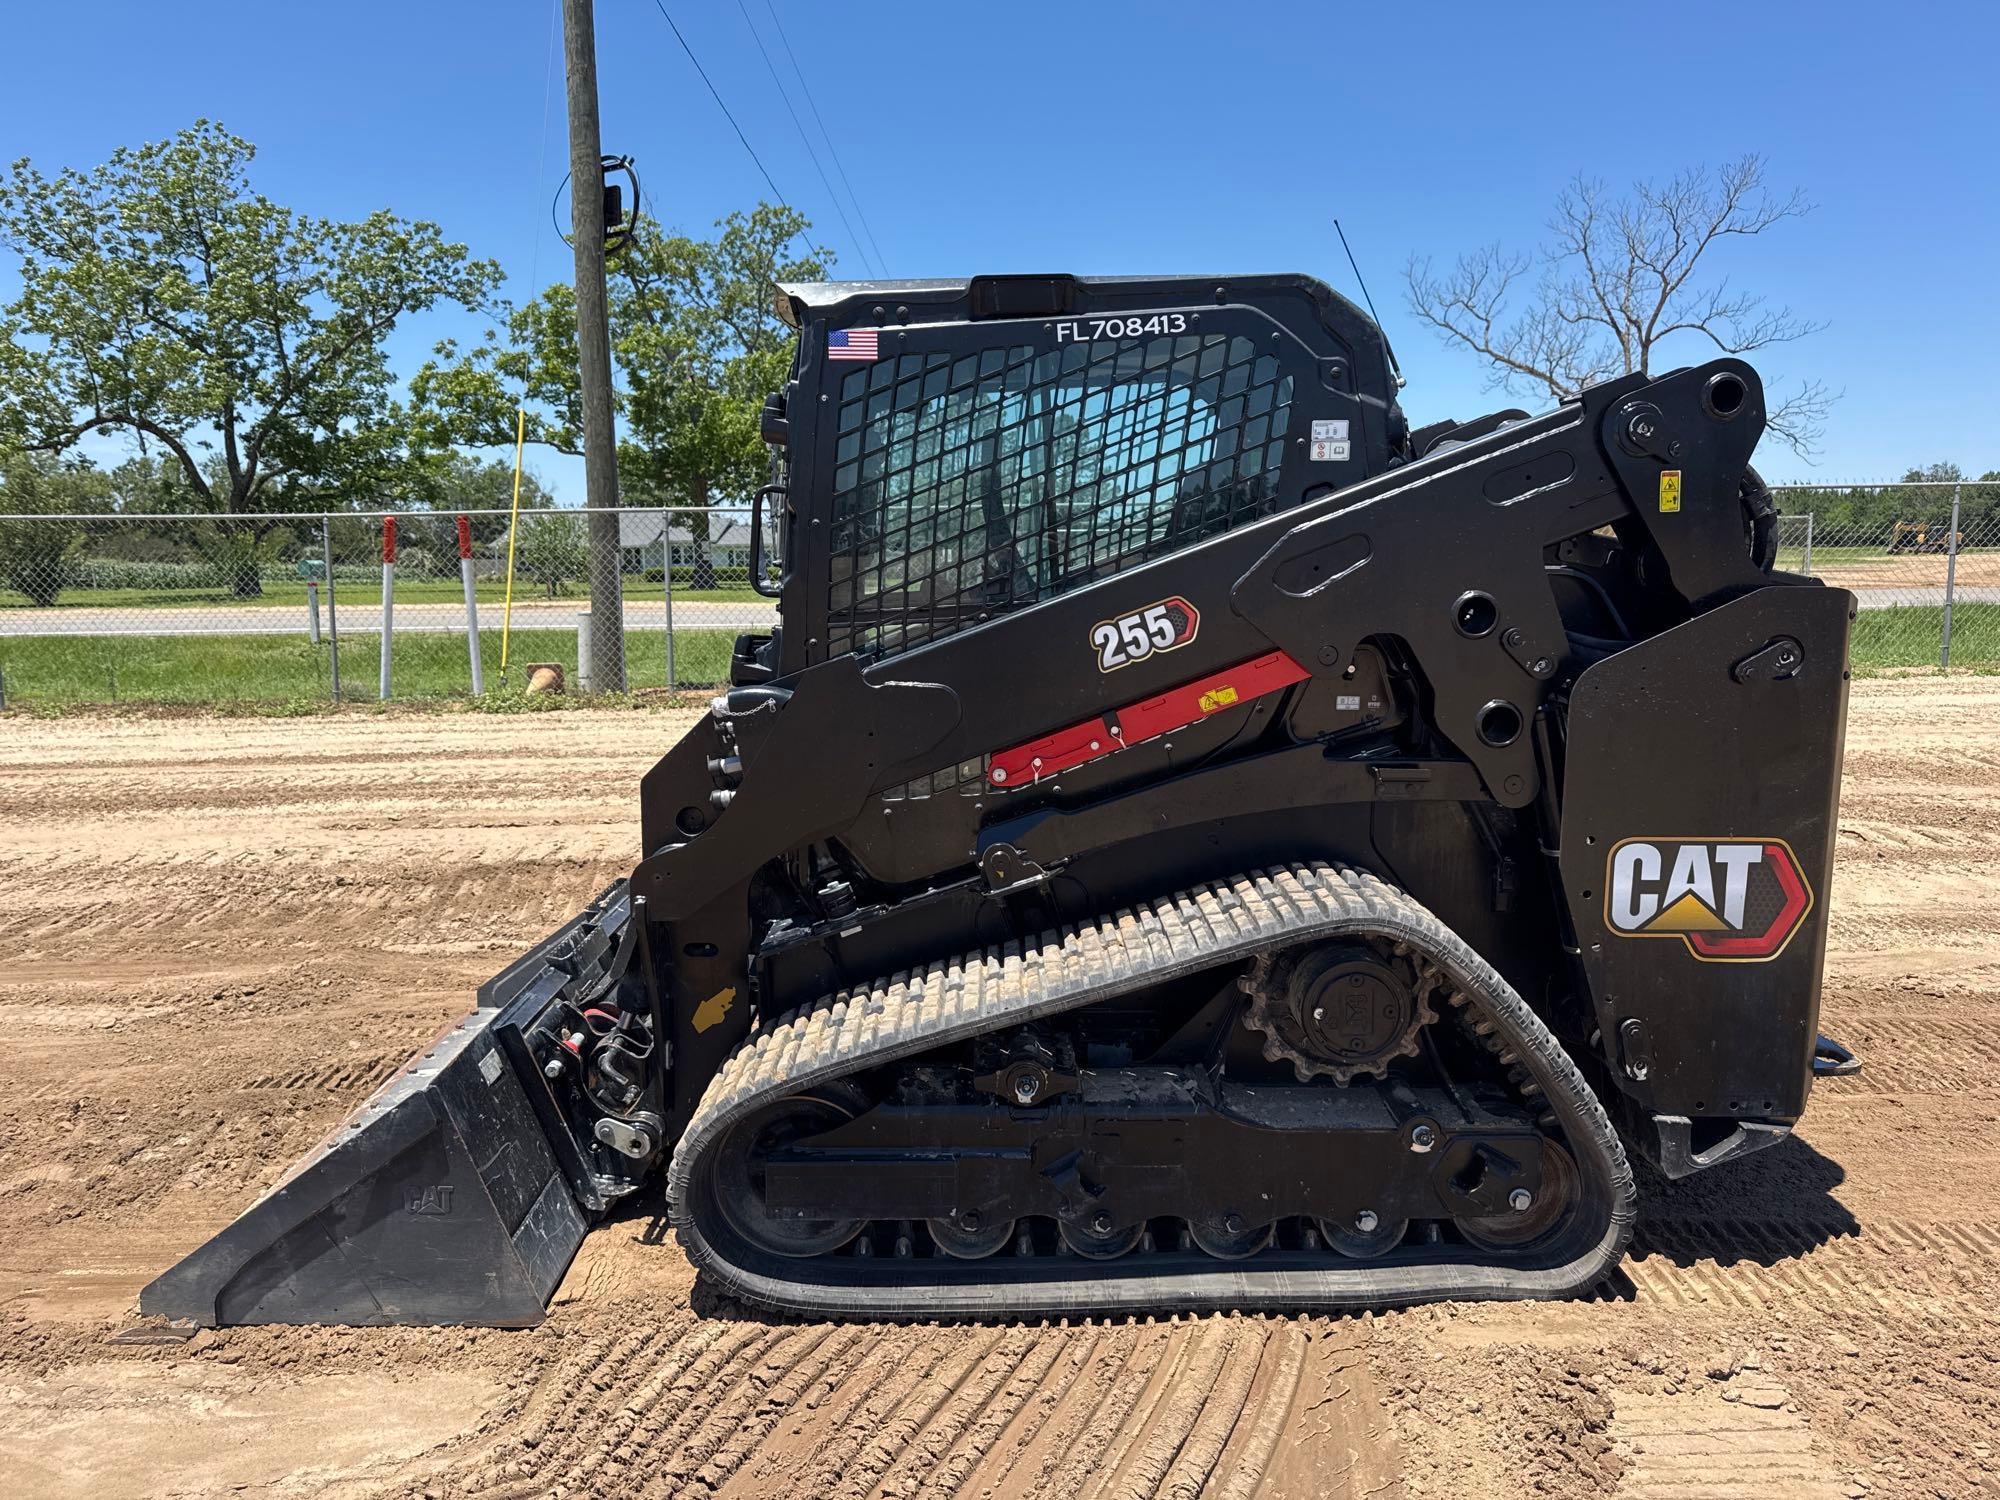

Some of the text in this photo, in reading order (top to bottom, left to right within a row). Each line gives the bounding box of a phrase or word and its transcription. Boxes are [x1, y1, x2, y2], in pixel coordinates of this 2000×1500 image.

[1056, 314, 1187, 343] FL708413
[1094, 605, 1176, 668] 255
[1611, 843, 1763, 930] CAT
[404, 1185, 454, 1215] CAT
